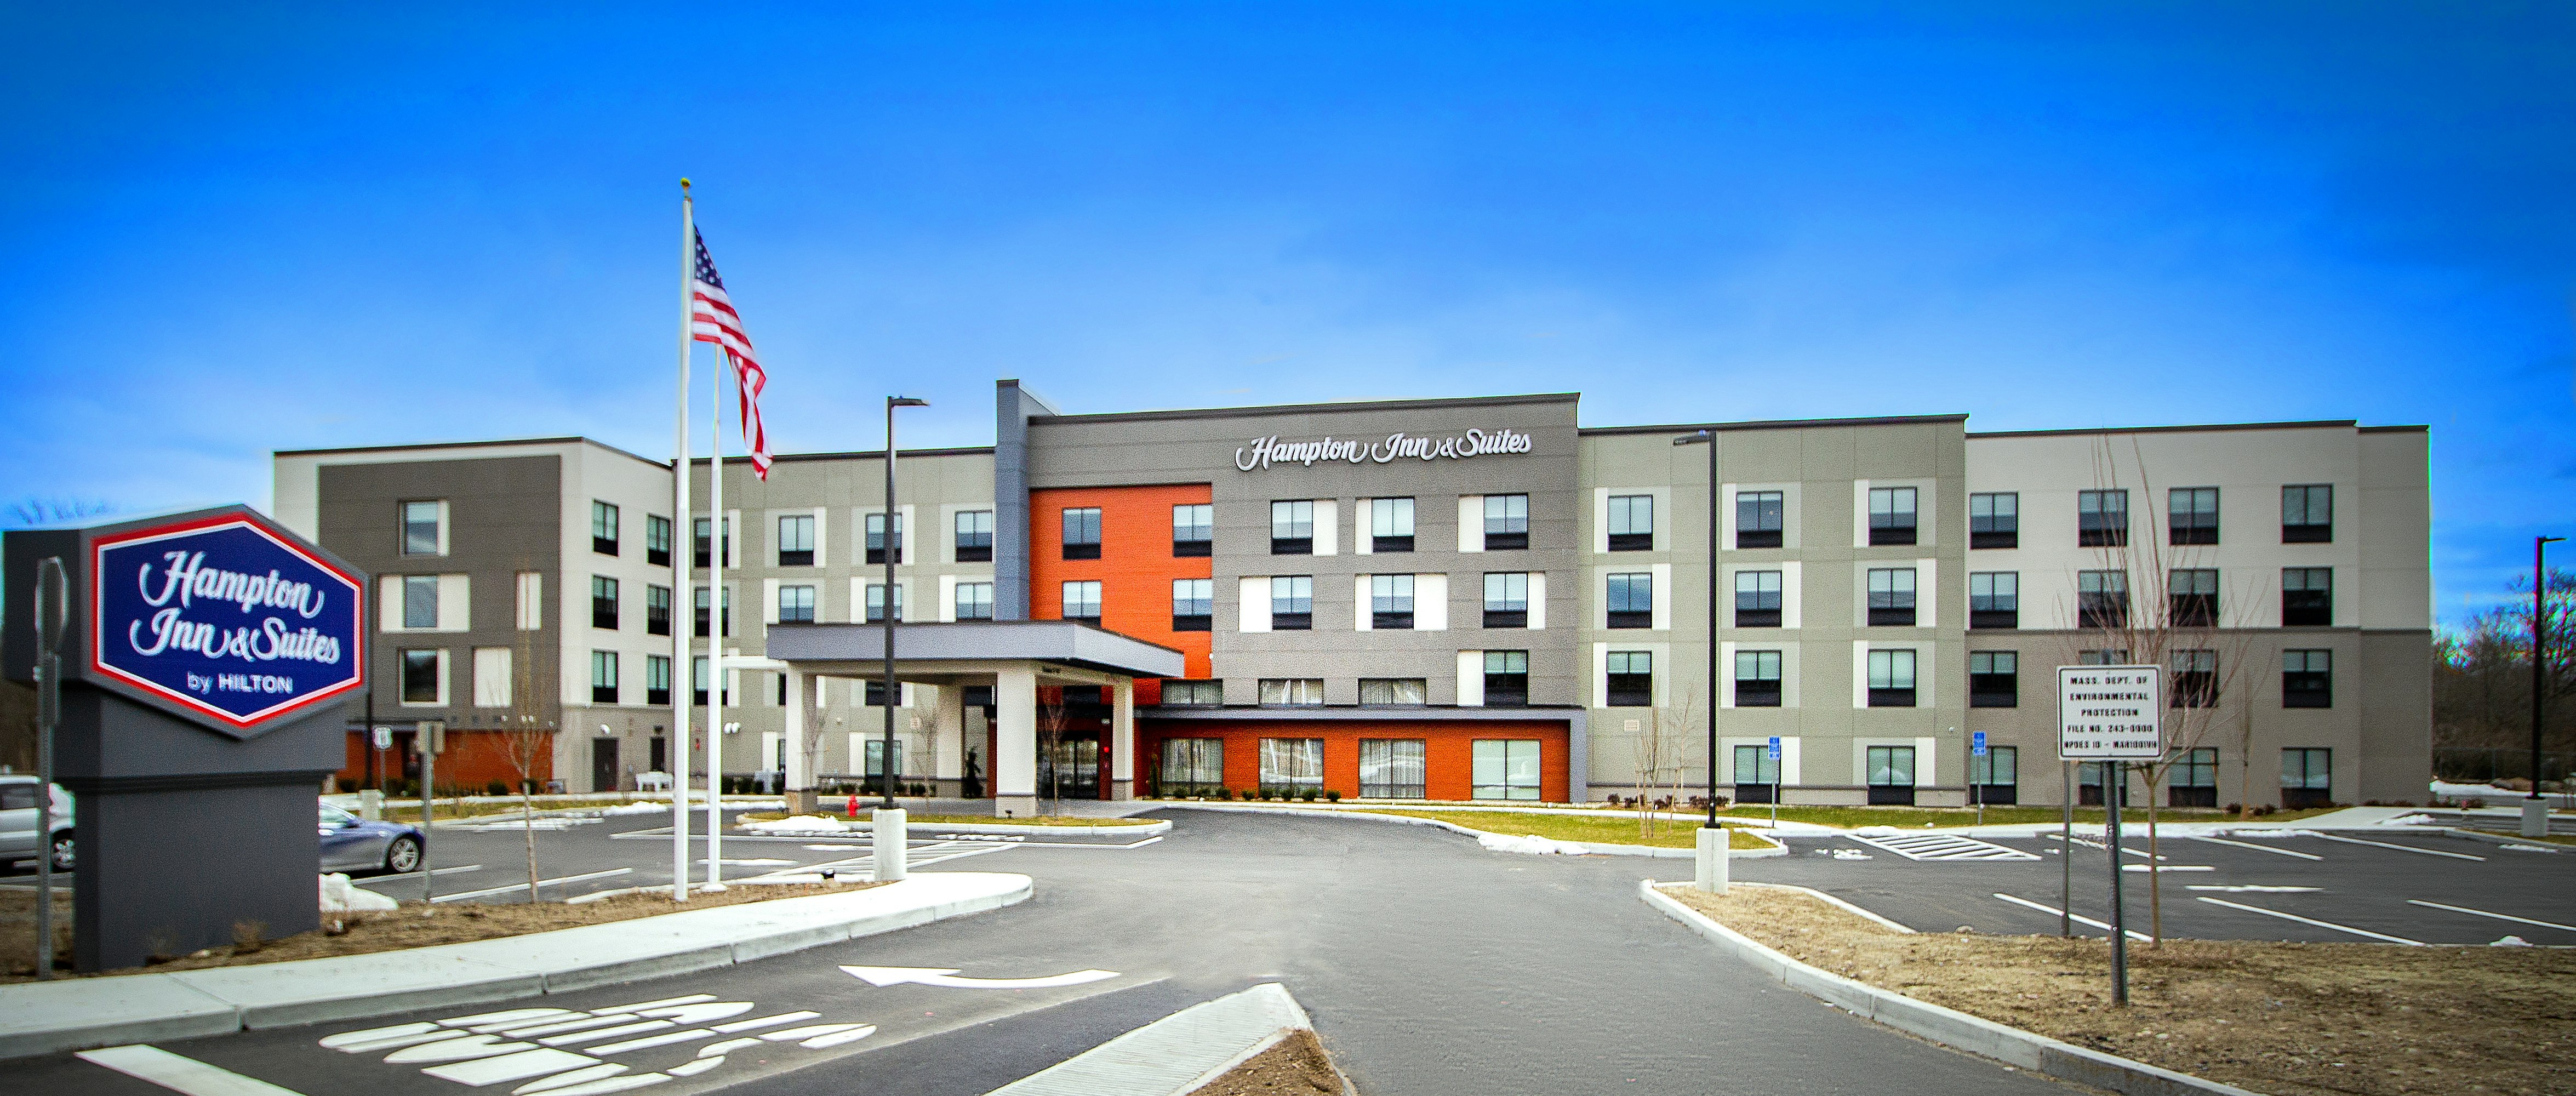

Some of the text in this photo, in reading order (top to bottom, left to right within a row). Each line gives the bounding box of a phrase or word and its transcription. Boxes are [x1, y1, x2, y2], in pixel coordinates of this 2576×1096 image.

[1235, 435, 1369, 472] Hampton
[139, 550, 325, 619] Hampton
[187, 671, 294, 695] by HILTON
[2069, 675, 2147, 685] MASS. DEPT. OF
[2069, 692, 2149, 701] ENVIRONMENTAL
[2080, 708, 2139, 717] PROTECTION
[2066, 724, 2084, 733] FILE
[2088, 724, 2103, 733] NO.
[2063, 740, 2089, 749] NPDES
[318, 993, 878, 1096] STOP
